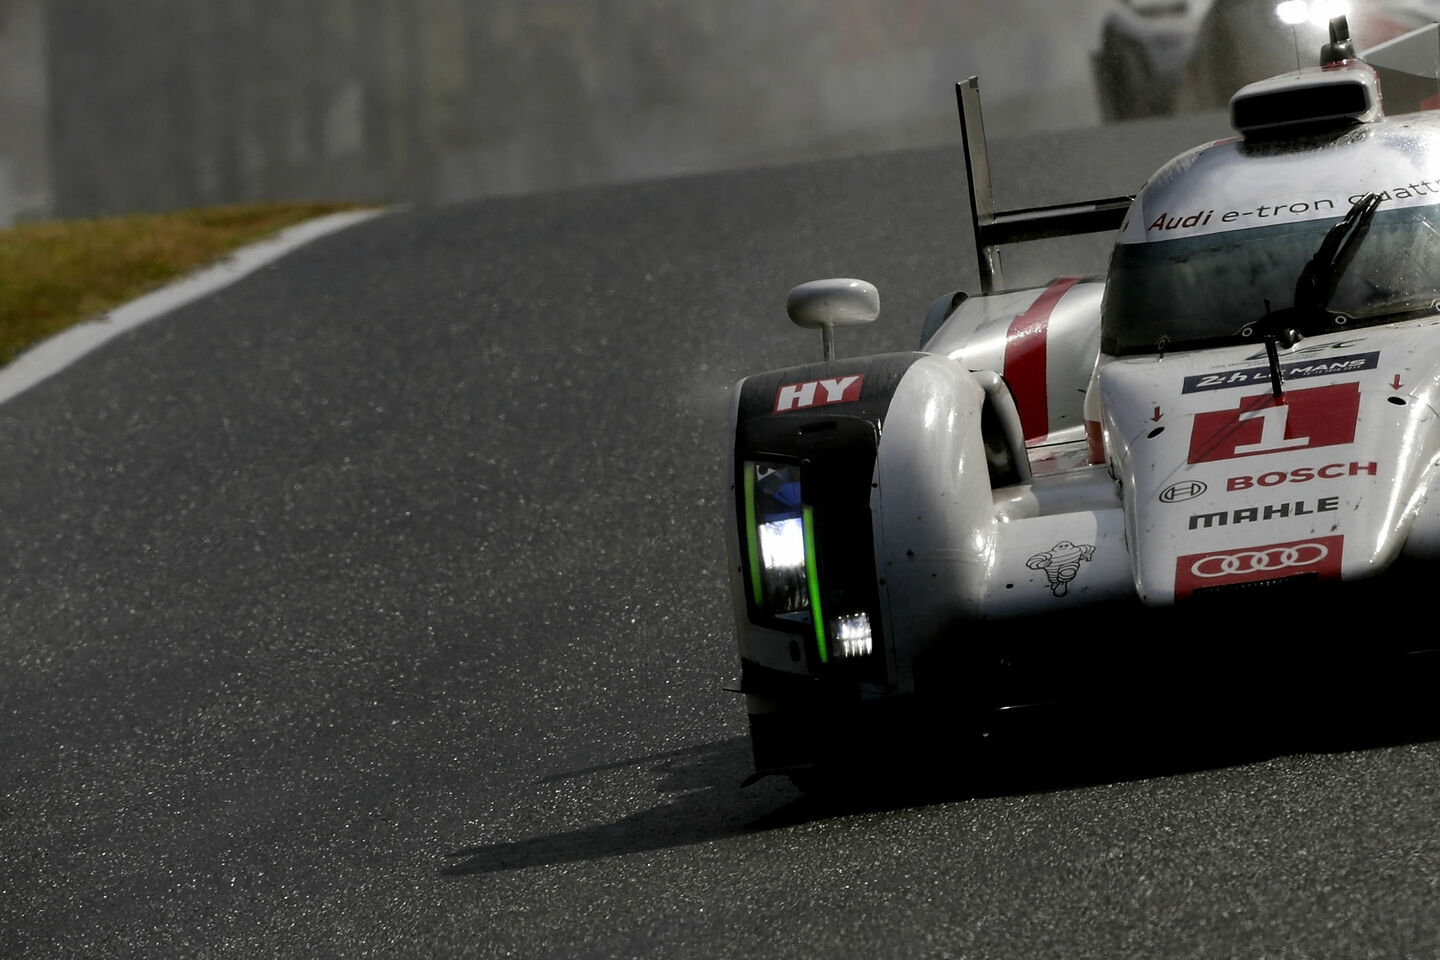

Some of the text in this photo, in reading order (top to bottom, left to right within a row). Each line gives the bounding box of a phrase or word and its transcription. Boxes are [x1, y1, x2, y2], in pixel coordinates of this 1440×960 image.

[1148, 208, 1214, 233] Audi
[1220, 199, 1334, 224] e-tron
[1289, 360, 1366, 375] MANS
[775, 375, 860, 411] HY
[1233, 404, 1310, 455] 1
[1226, 461, 1378, 492] BOSCH
[1188, 496, 1340, 531] MAHLE
